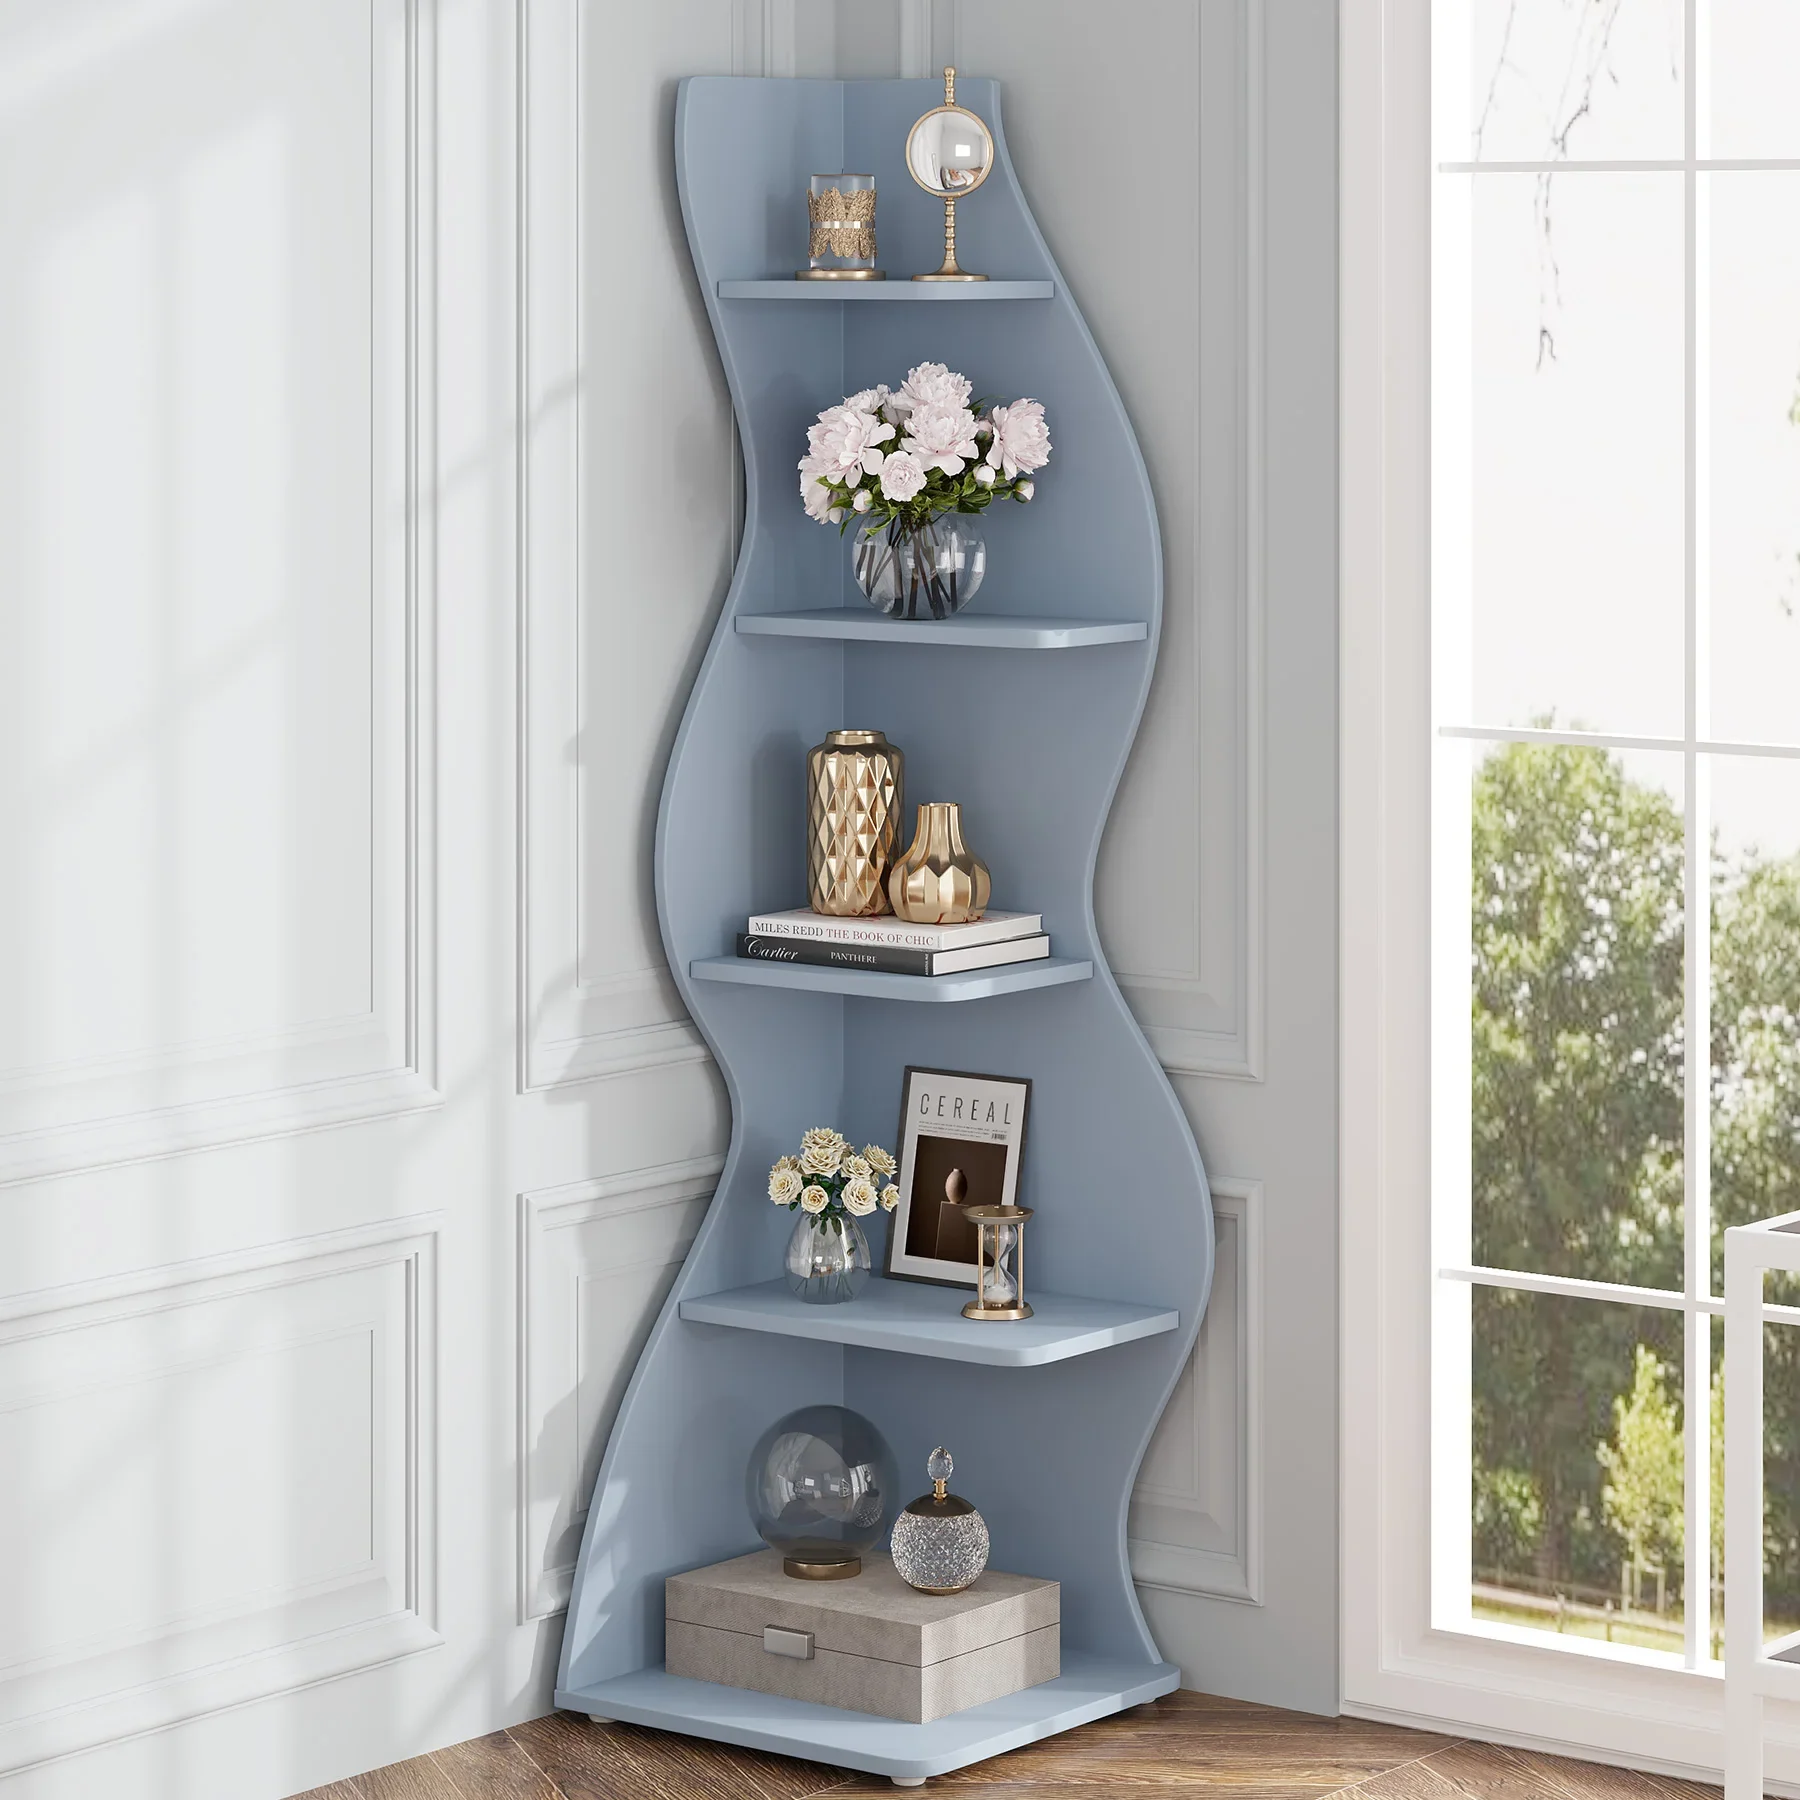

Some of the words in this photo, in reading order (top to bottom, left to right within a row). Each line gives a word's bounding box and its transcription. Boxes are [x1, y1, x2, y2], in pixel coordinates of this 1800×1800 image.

[754, 922, 790, 934] MILES
[792, 925, 823, 937] REDD
[826, 928, 850, 940] THE
[853, 931, 885, 943] BOOK
[887, 934, 902, 944] OF
[905, 935, 934, 946] CHIC
[744, 935, 799, 961] Cartier
[919, 1093, 1012, 1125] CEREAL
